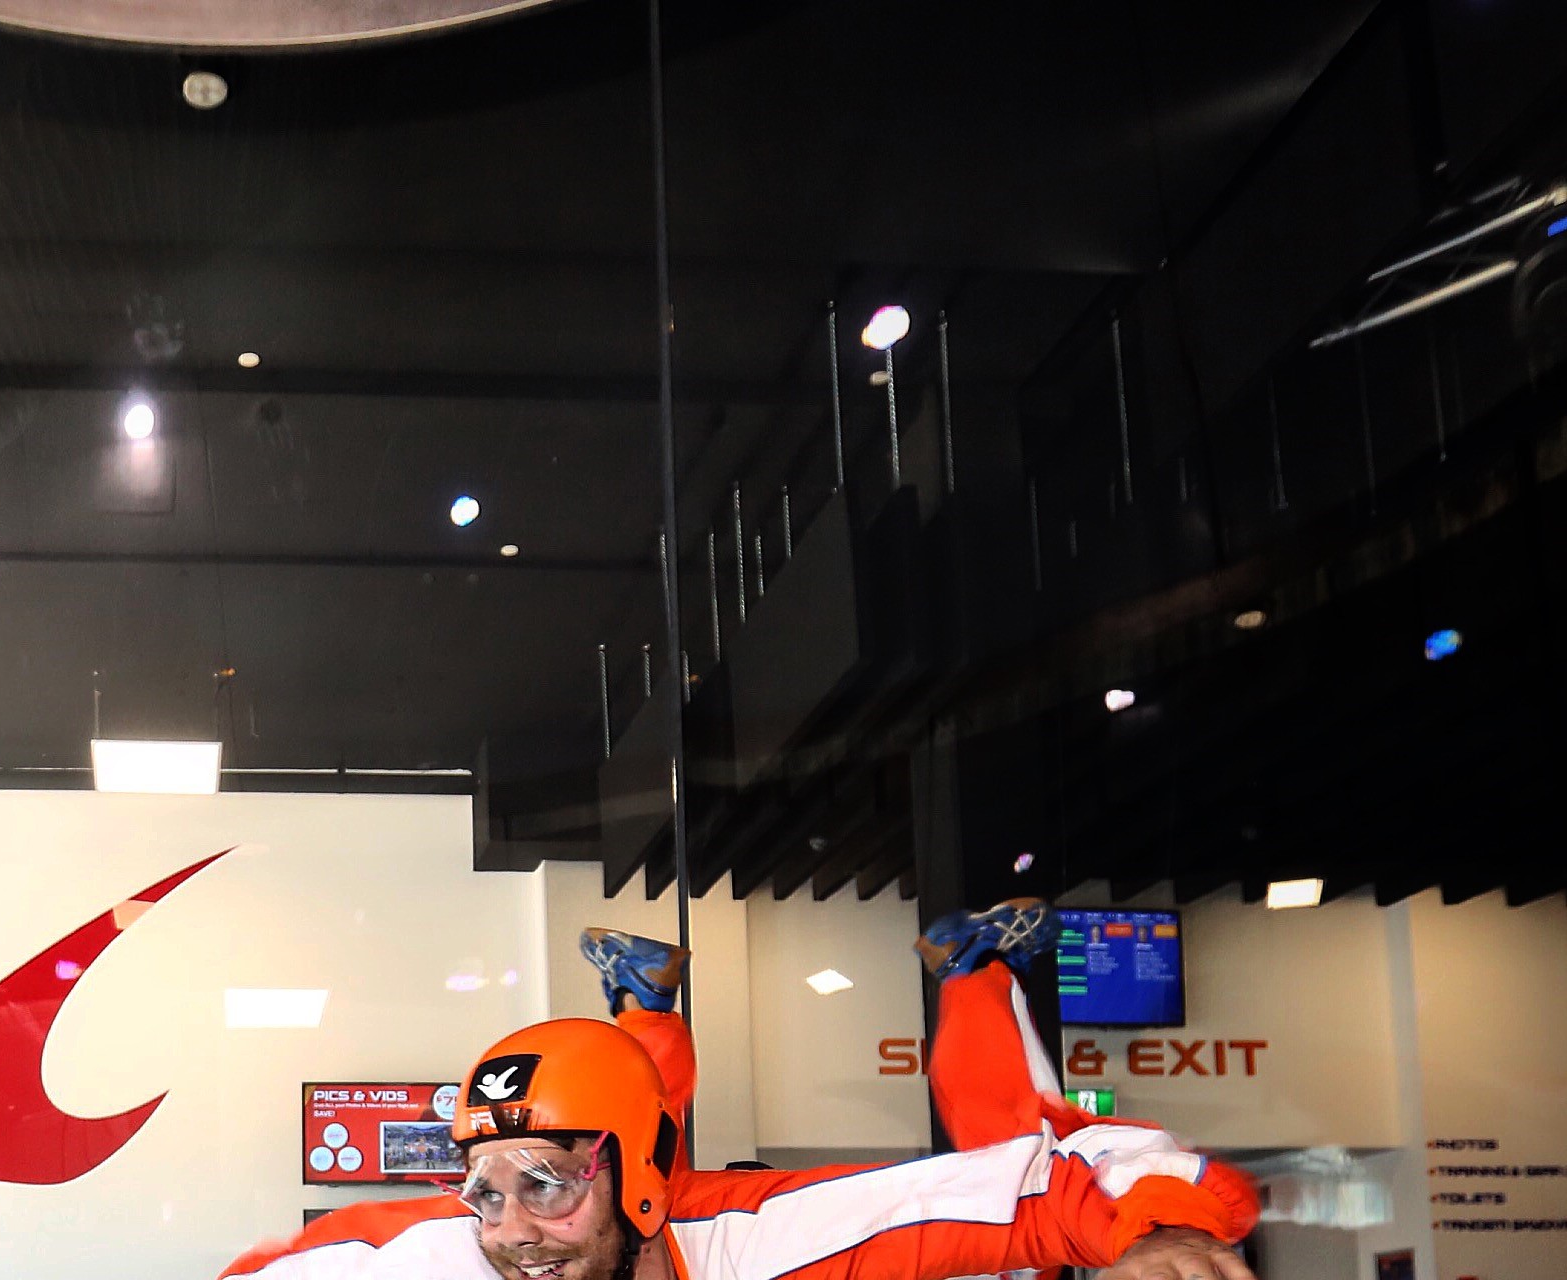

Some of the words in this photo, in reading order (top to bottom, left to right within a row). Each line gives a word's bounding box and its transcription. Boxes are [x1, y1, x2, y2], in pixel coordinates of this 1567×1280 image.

[1067, 1039, 1108, 1076] &
[1128, 1039, 1269, 1076] EXIT
[313, 1090, 350, 1101] PICS
[353, 1090, 366, 1101] &
[369, 1090, 408, 1101] VIDS
